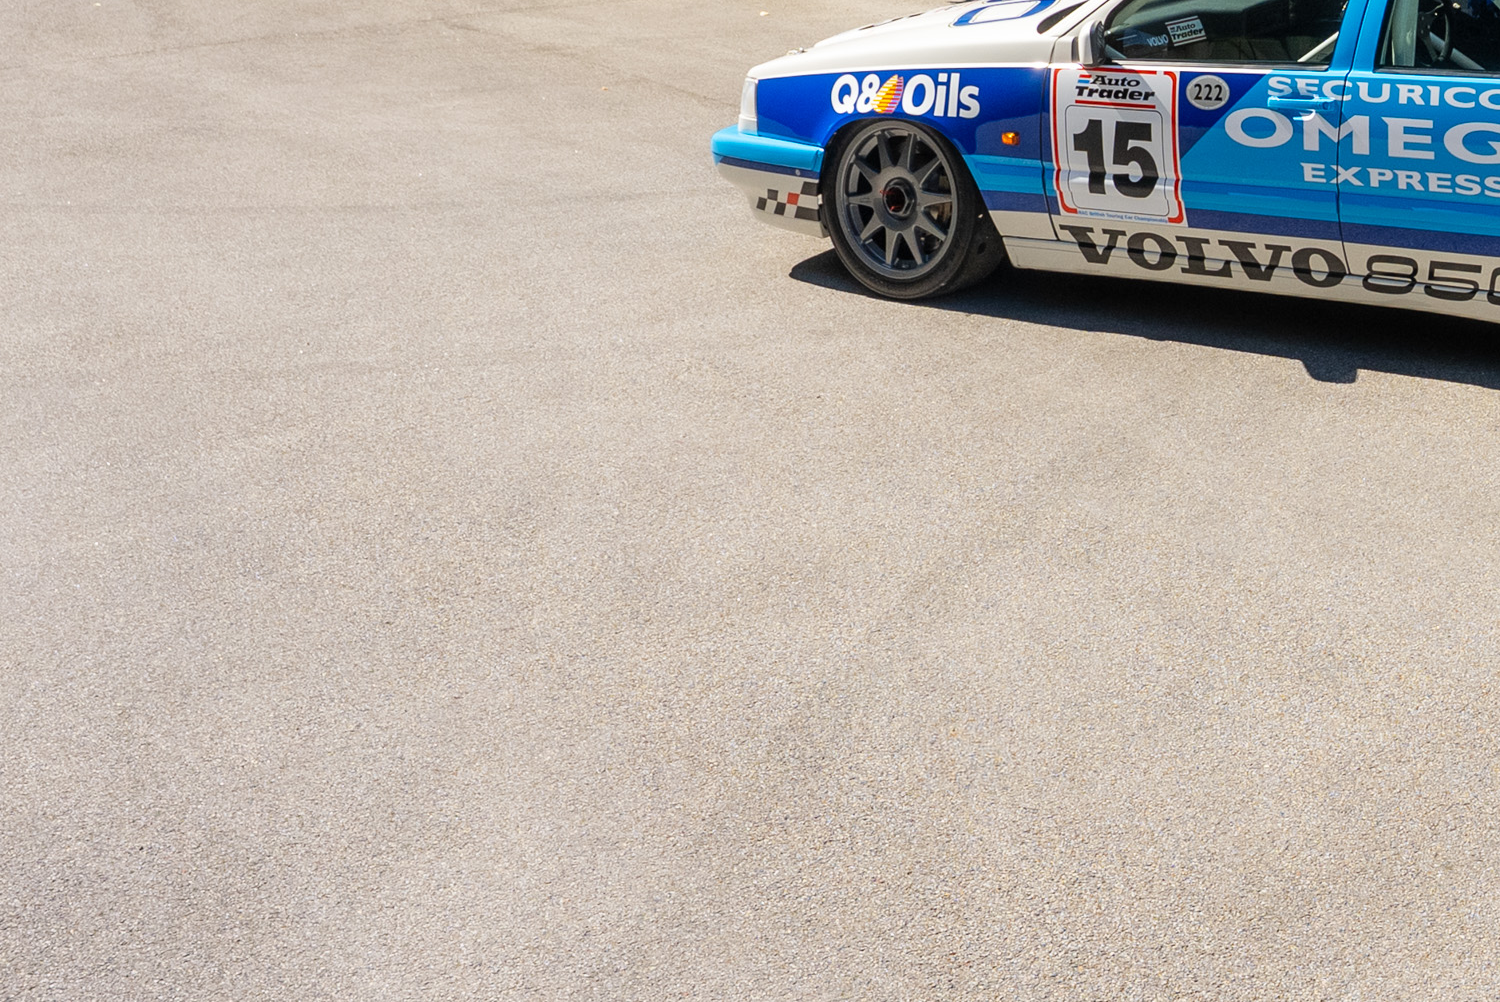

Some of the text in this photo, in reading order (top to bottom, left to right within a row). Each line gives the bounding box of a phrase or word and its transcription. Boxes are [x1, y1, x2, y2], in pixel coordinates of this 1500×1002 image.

[1171, 28, 1204, 41] Trader
[1175, 23, 1196, 33] Auto
[1147, 34, 1169, 47] VOLVO
[1090, 75, 1140, 87] Auto
[831, 72, 981, 119] Q8 Oils
[1075, 86, 1156, 101] Trader
[1193, 83, 1223, 102] 222
[1073, 119, 1160, 199] 15
[1058, 224, 1348, 288] VOLVO
